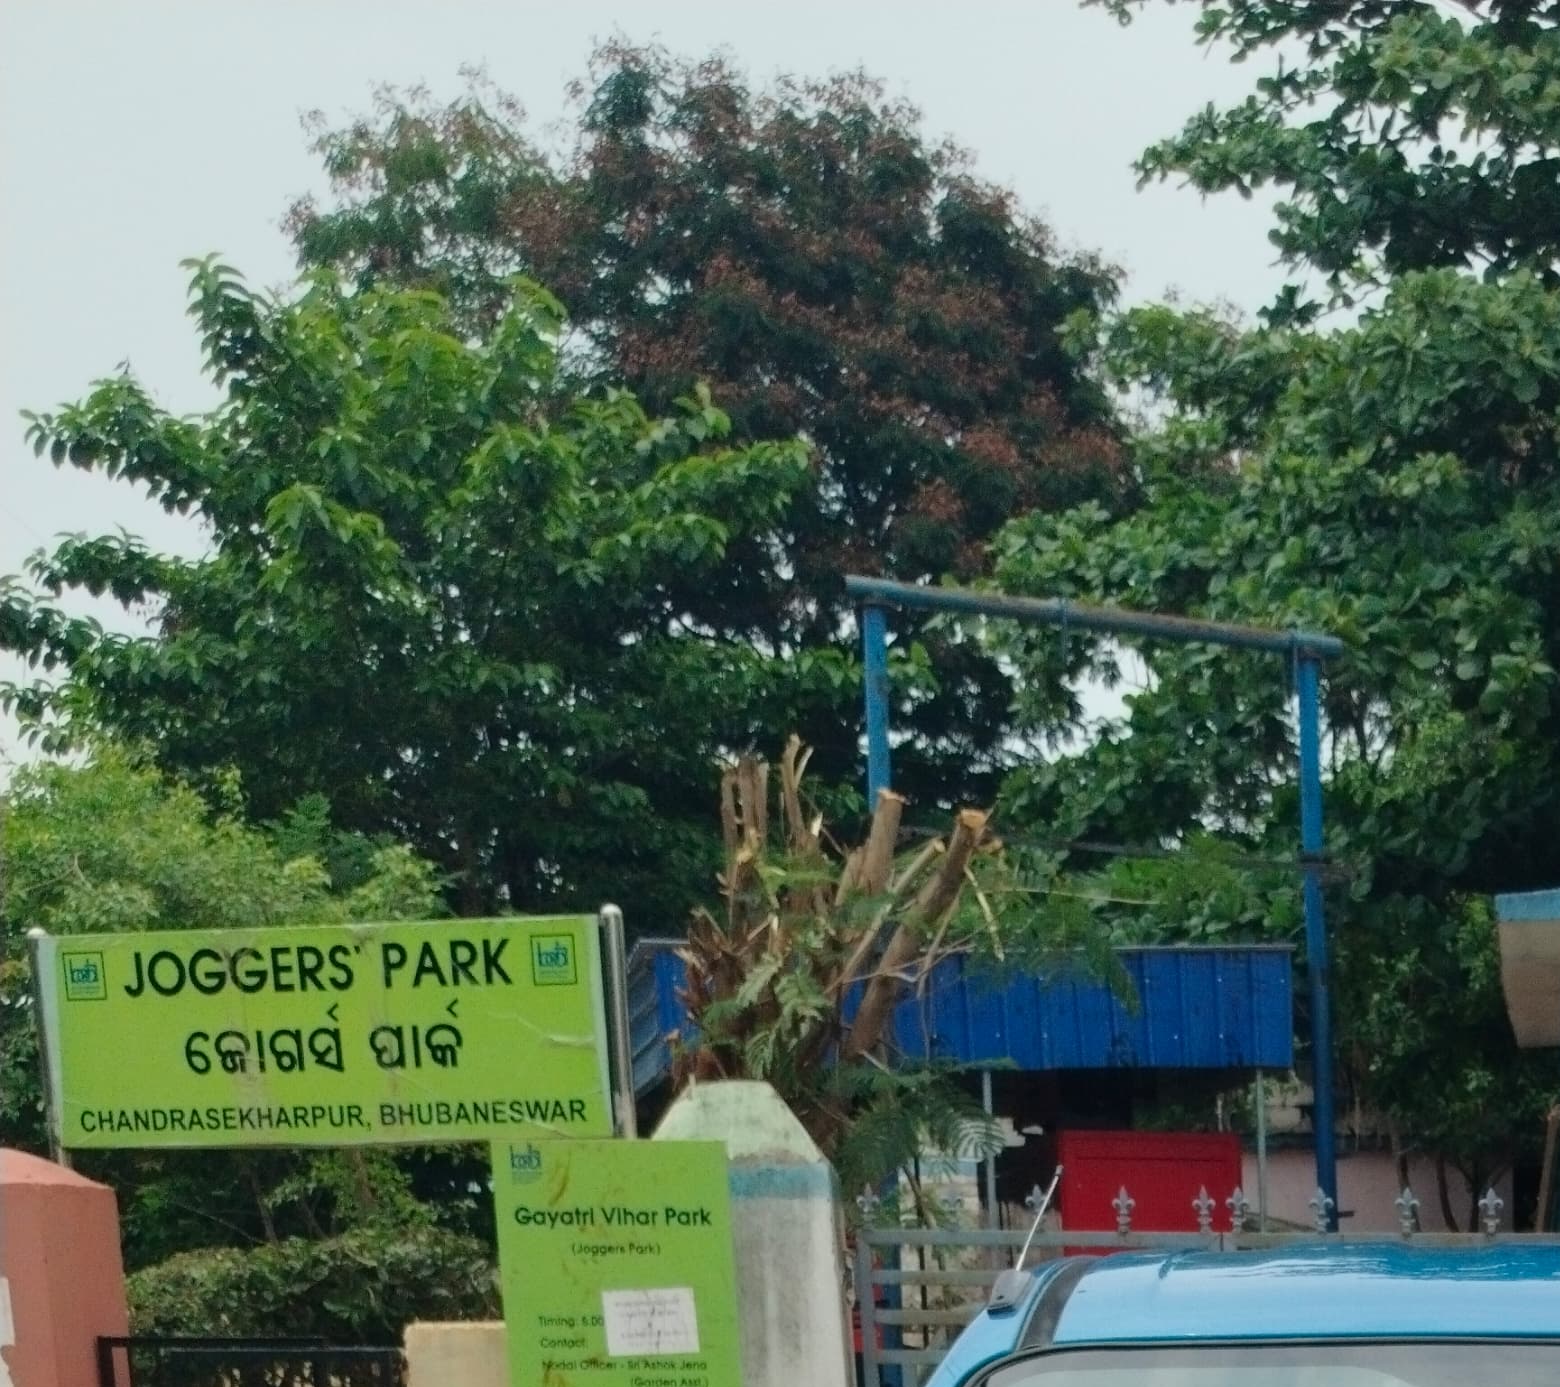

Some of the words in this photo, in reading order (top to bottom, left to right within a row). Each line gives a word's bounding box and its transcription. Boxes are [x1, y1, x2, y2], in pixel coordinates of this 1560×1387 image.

[124, 944, 361, 998] JOGGERS'
[382, 938, 513, 988] PARK
[369, 998, 463, 1069] ପାର୍କ
[80, 1105, 371, 1132] CHANDRASEKHARPUR,
[380, 1100, 587, 1126] BHUBANESWAR
[514, 1207, 594, 1229] Gayatri
[601, 1207, 658, 1227] Vihar
[665, 1206, 712, 1226] Park
[571, 1243, 625, 1257] (Joggers
[629, 1243, 661, 1256] Park)
